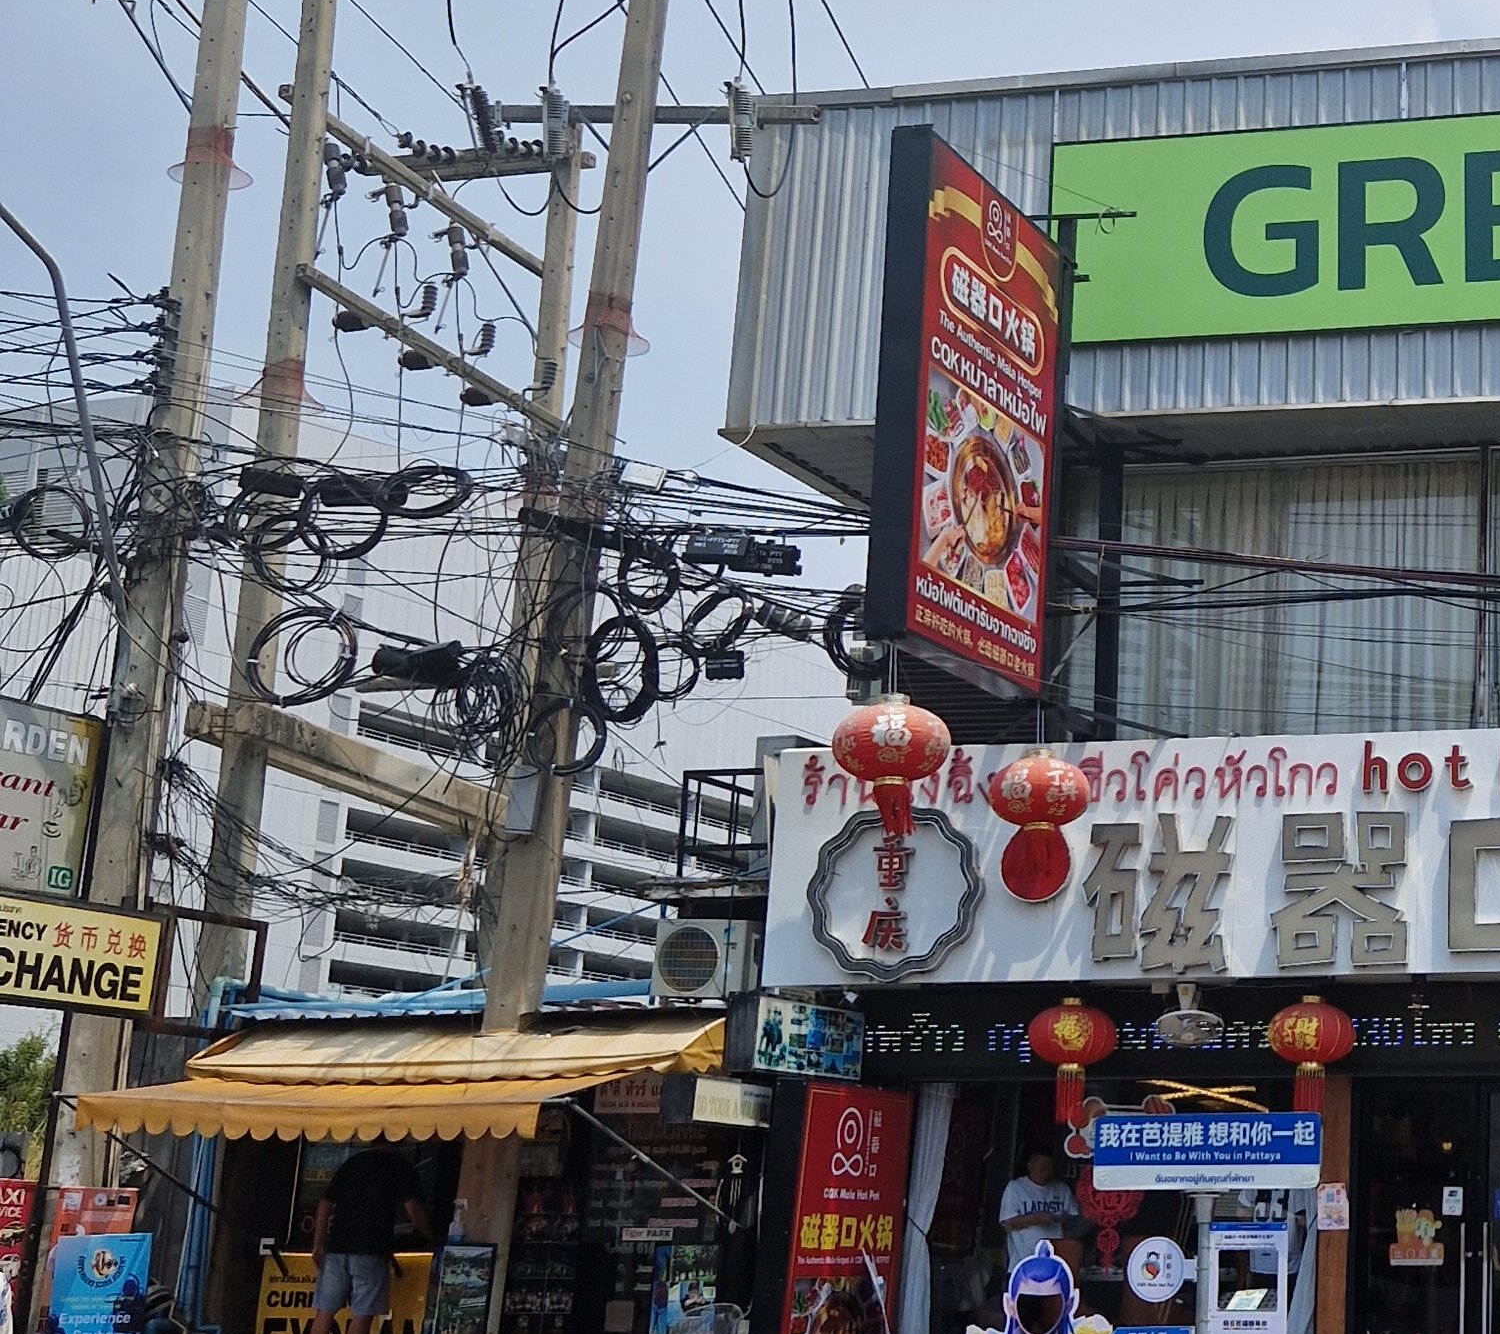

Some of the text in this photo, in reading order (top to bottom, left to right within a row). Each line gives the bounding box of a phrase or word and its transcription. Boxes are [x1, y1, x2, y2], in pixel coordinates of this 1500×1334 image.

[951, 262, 1036, 362] 磁器口火锅
[939, 308, 1043, 401] The Authentic Mala Hotpot
[0, 719, 89, 768] RDEN
[0, 770, 54, 799] ant
[1361, 740, 1474, 794] hot
[50, 869, 72, 890] IG
[862, 835, 912, 952] 重庆
[52, 920, 148, 961] 货币兑换
[1099, 1119, 1316, 1148] 我在芭提雅 想和你一起
[1135, 1152, 1161, 1161] Want
[1162, 1152, 1173, 1161] to
[1174, 1152, 1186, 1161] Be
[1188, 1151, 1212, 1161] With
[1214, 1151, 1231, 1161] You
[1233, 1150, 1243, 1160] in
[1244, 1151, 1282, 1162] Pattaya
[800, 1212, 894, 1252] 磁器口火锅
[58, 1312, 132, 1327] Experience
